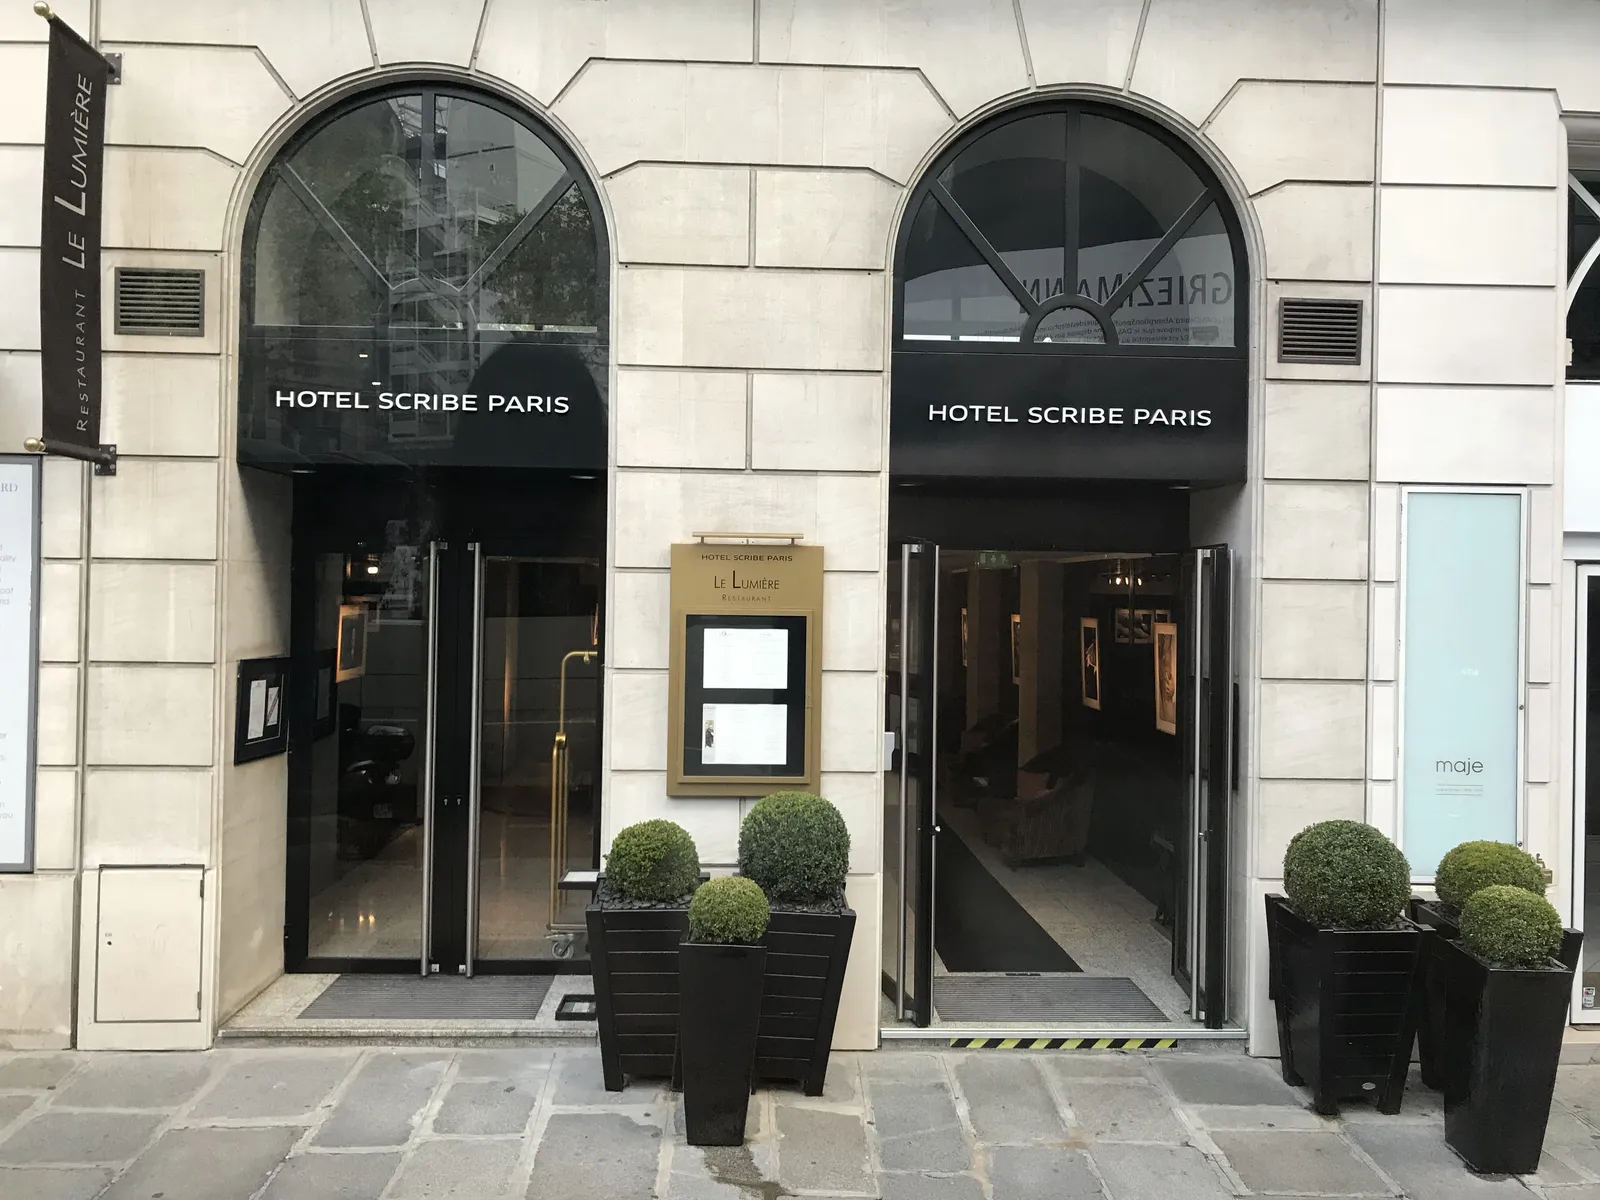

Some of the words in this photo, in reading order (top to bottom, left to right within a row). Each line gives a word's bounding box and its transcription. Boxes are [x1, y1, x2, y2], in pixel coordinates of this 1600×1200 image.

[62, 232, 86, 271] LE
[275, 390, 369, 409] HOTEL
[378, 392, 478, 412] SCRIBE
[488, 394, 570, 414] PARIS
[928, 404, 1019, 423] HOTEL
[1027, 406, 1124, 424] SCRIBE
[1134, 408, 1212, 427] PARIS
[701, 554, 731, 562] HOTEL
[733, 554, 765, 562] SCRIBE
[1436, 757, 1484, 776] maje
